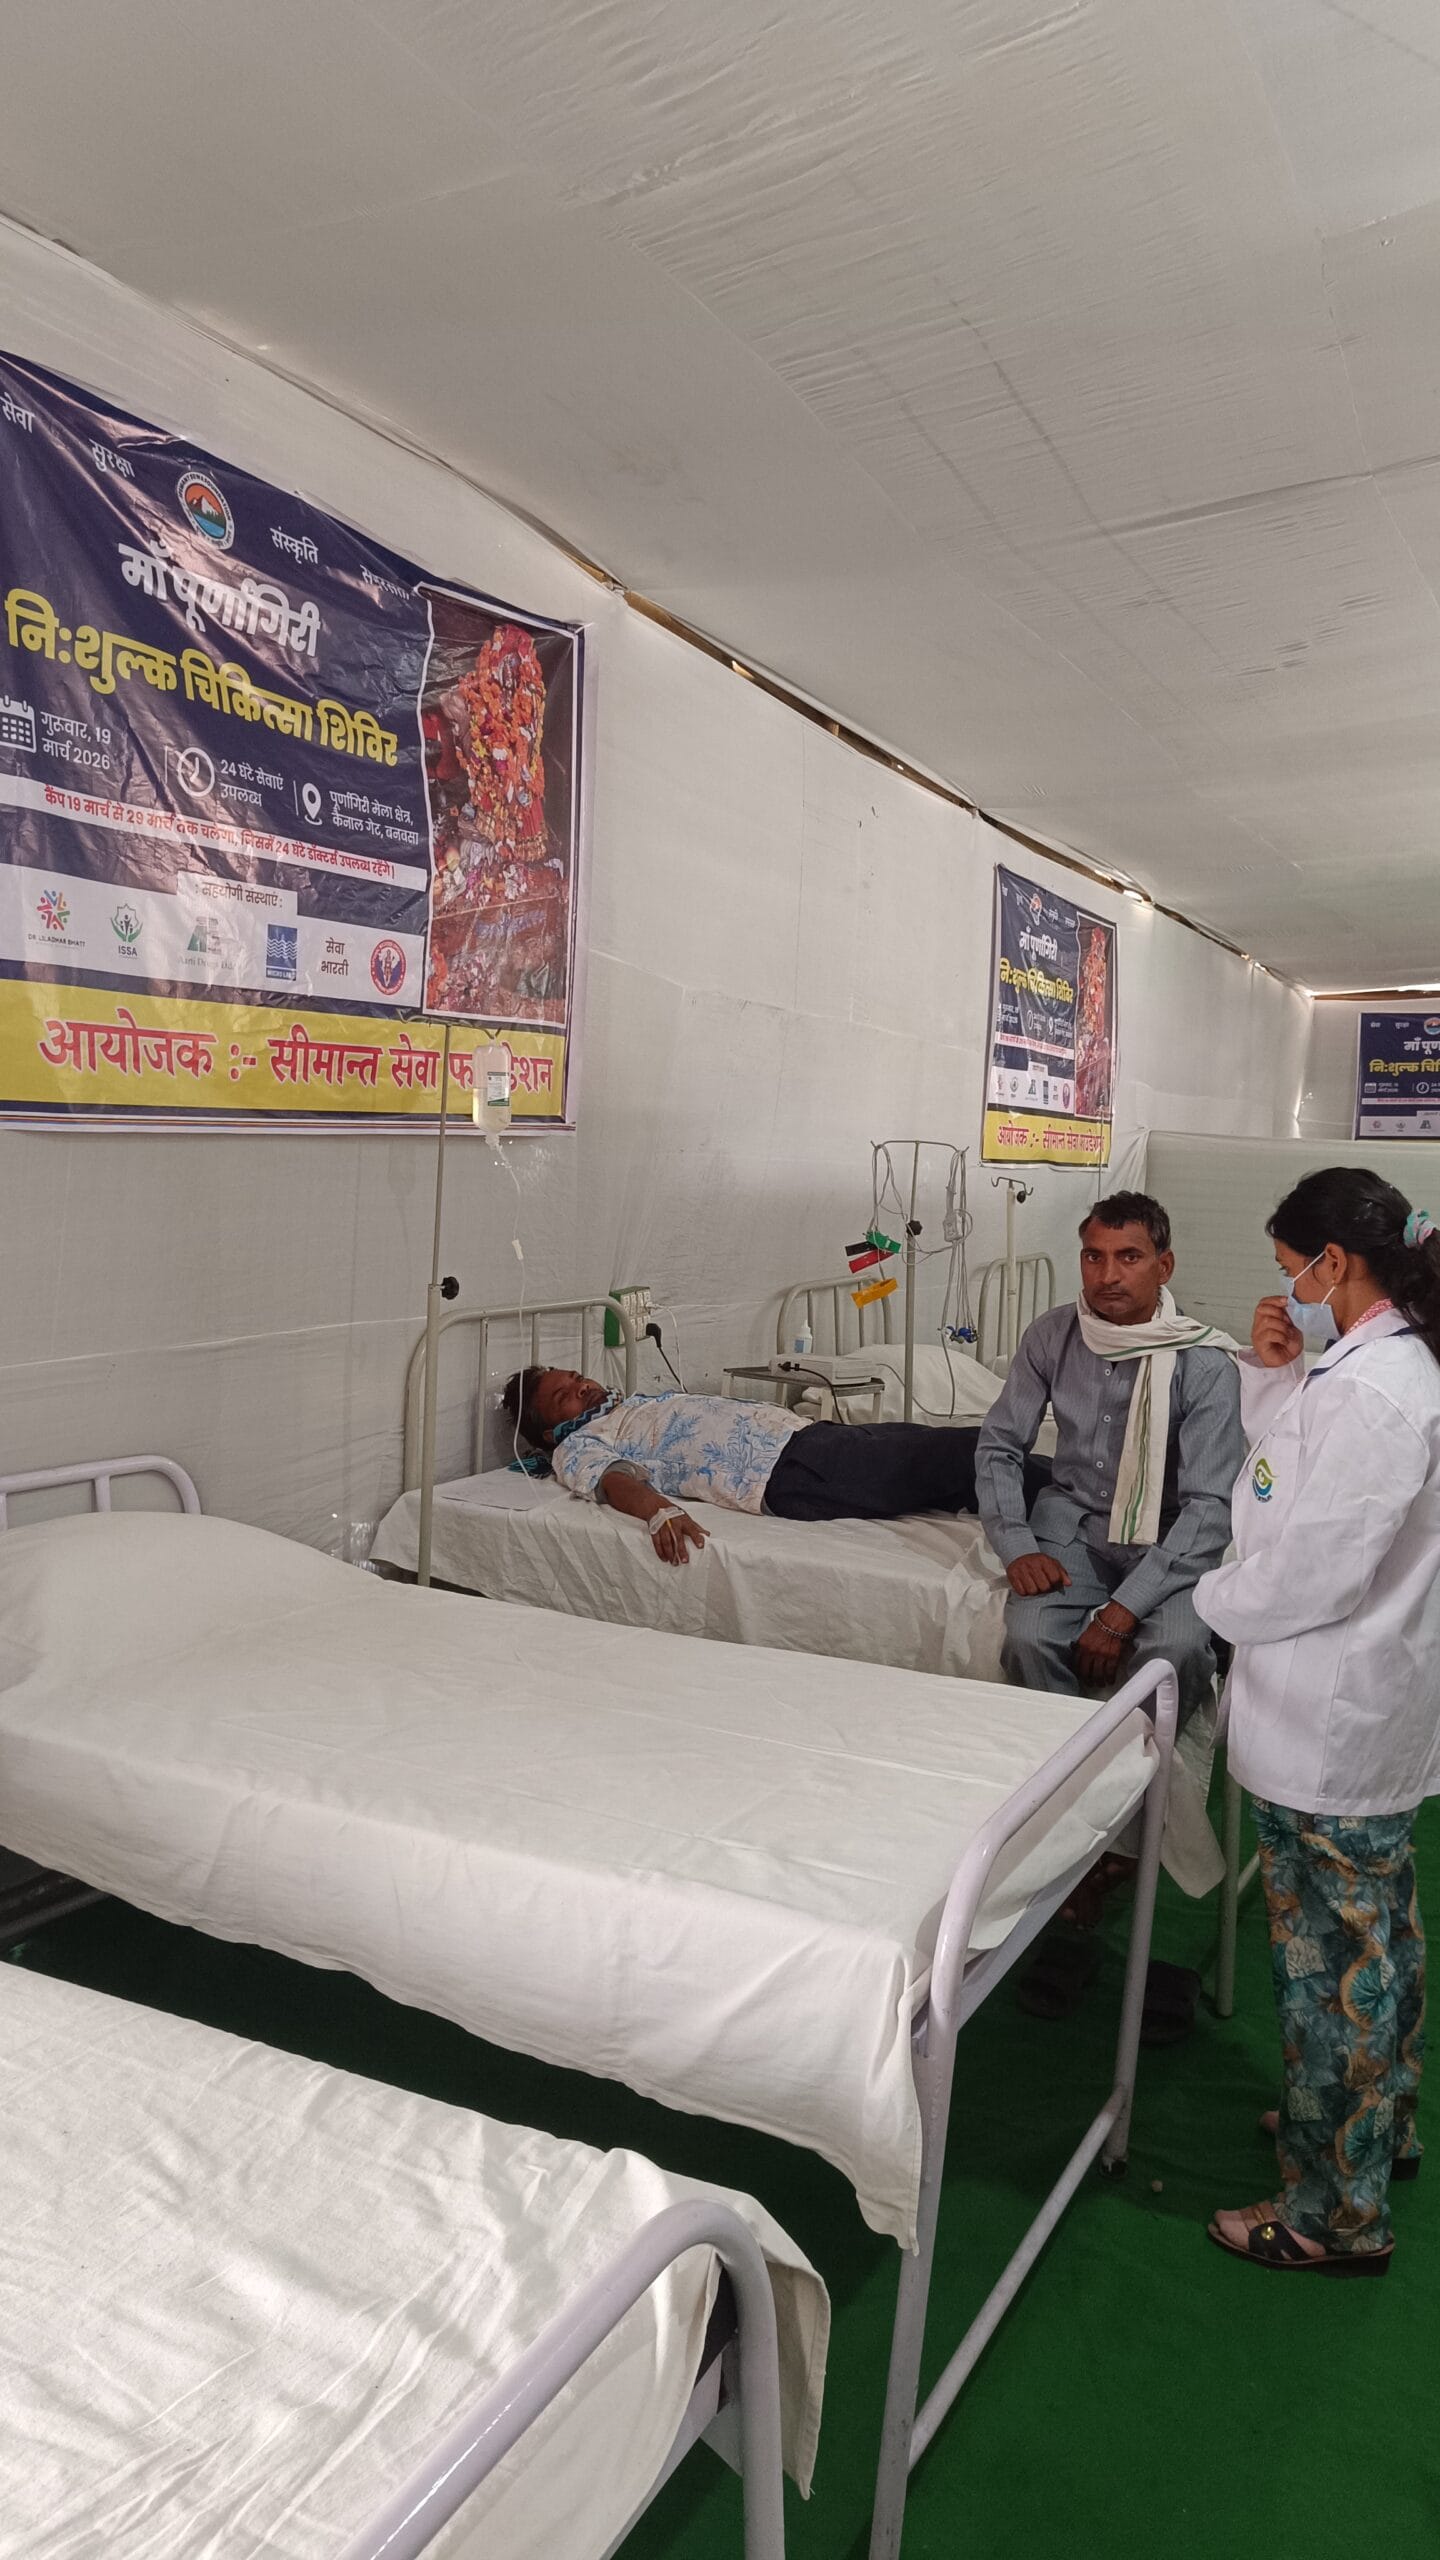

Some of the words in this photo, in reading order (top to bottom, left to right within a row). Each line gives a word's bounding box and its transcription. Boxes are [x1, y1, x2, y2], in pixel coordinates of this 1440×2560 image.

[0, 392, 37, 434] सेवा
[88, 439, 135, 478] सुरक्षा
[269, 526, 319, 564] संस्कृति
[118, 540, 171, 601] माँ
[180, 648, 313, 738] चिकित्सा
[316, 698, 399, 768] शिविर
[95, 727, 111, 745] 19
[42, 737, 73, 761] मार्च
[73, 747, 110, 770] 2026
[220, 759, 237, 776] 24
[237, 762, 255, 781] घंटे
[255, 766, 284, 791] सेवाएं
[67, 795, 81, 812] 19
[84, 798, 111, 818] मार्च
[112, 801, 124, 822] से
[126, 808, 144, 824] 29
[276, 840, 289, 855] 24
[330, 806, 364, 832] कैनाल
[371, 799, 393, 819] मेला
[394, 805, 414, 827] क्षेत्र,
[118, 945, 138, 956] ISSA
[325, 937, 346, 955] सेवा
[321, 959, 349, 976] भारती
[38, 1007, 218, 1079] आयोजक
[267, 1024, 383, 1088] सीमान्त
[388, 1033, 441, 1088] सेवा
